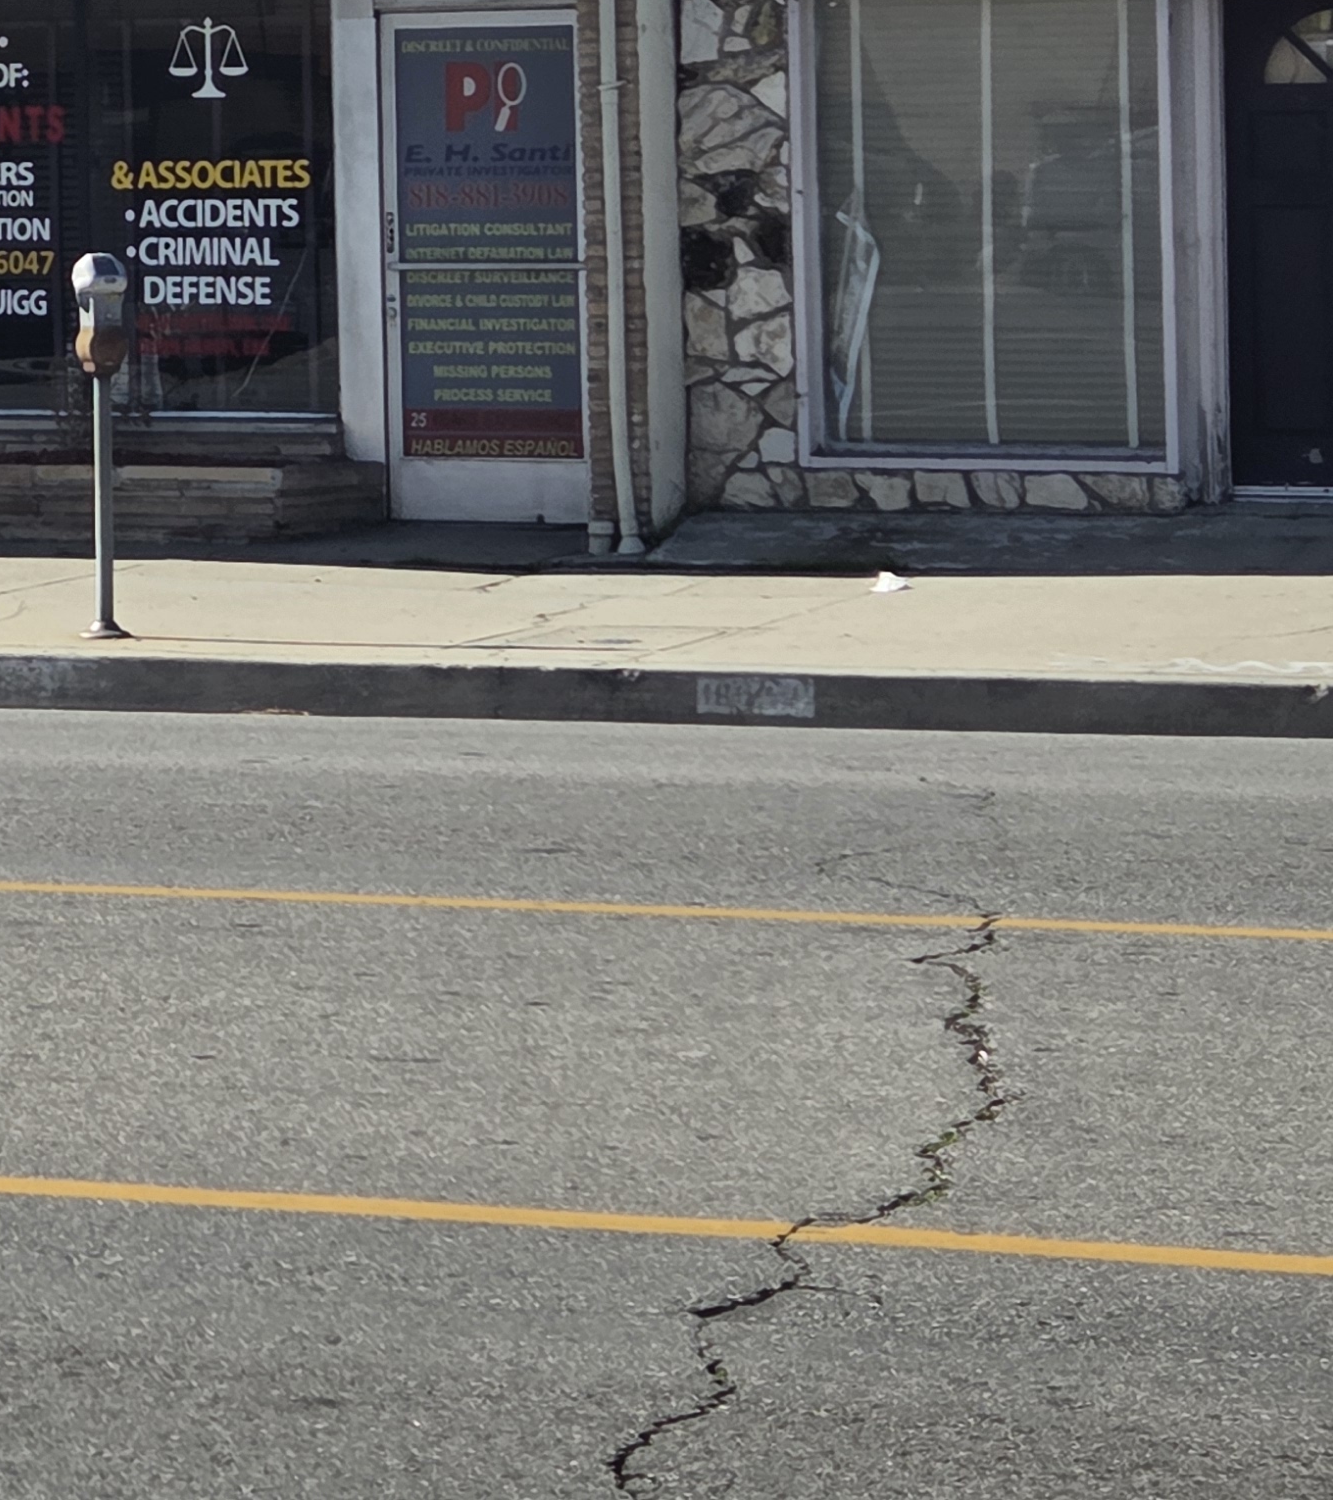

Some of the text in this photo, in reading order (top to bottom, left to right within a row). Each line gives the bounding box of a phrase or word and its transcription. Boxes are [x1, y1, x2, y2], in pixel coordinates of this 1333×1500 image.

[403, 144, 432, 163] E.
[445, 144, 479, 163] H.
[111, 159, 311, 190] & ASSOCIATES
[403, 165, 463, 177] PRIVATE
[138, 199, 300, 228] ACCIDENTS
[406, 222, 573, 237] LITIGATION CONSULTANT
[138, 237, 280, 267] CRIMINAL
[407, 271, 575, 284] DISCREET SURVEILLANCE
[143, 275, 272, 306] DEFENSE
[408, 318, 576, 331] FINANCIAL INVESTIGATOR
[408, 341, 576, 355] EXECUTIVE PROTECTION
[491, 365, 552, 378] PERSONS
[434, 389, 552, 402] PROCESS SERVICE
[410, 412, 427, 427] 25
[411, 438, 501, 455] HABLAMOS
